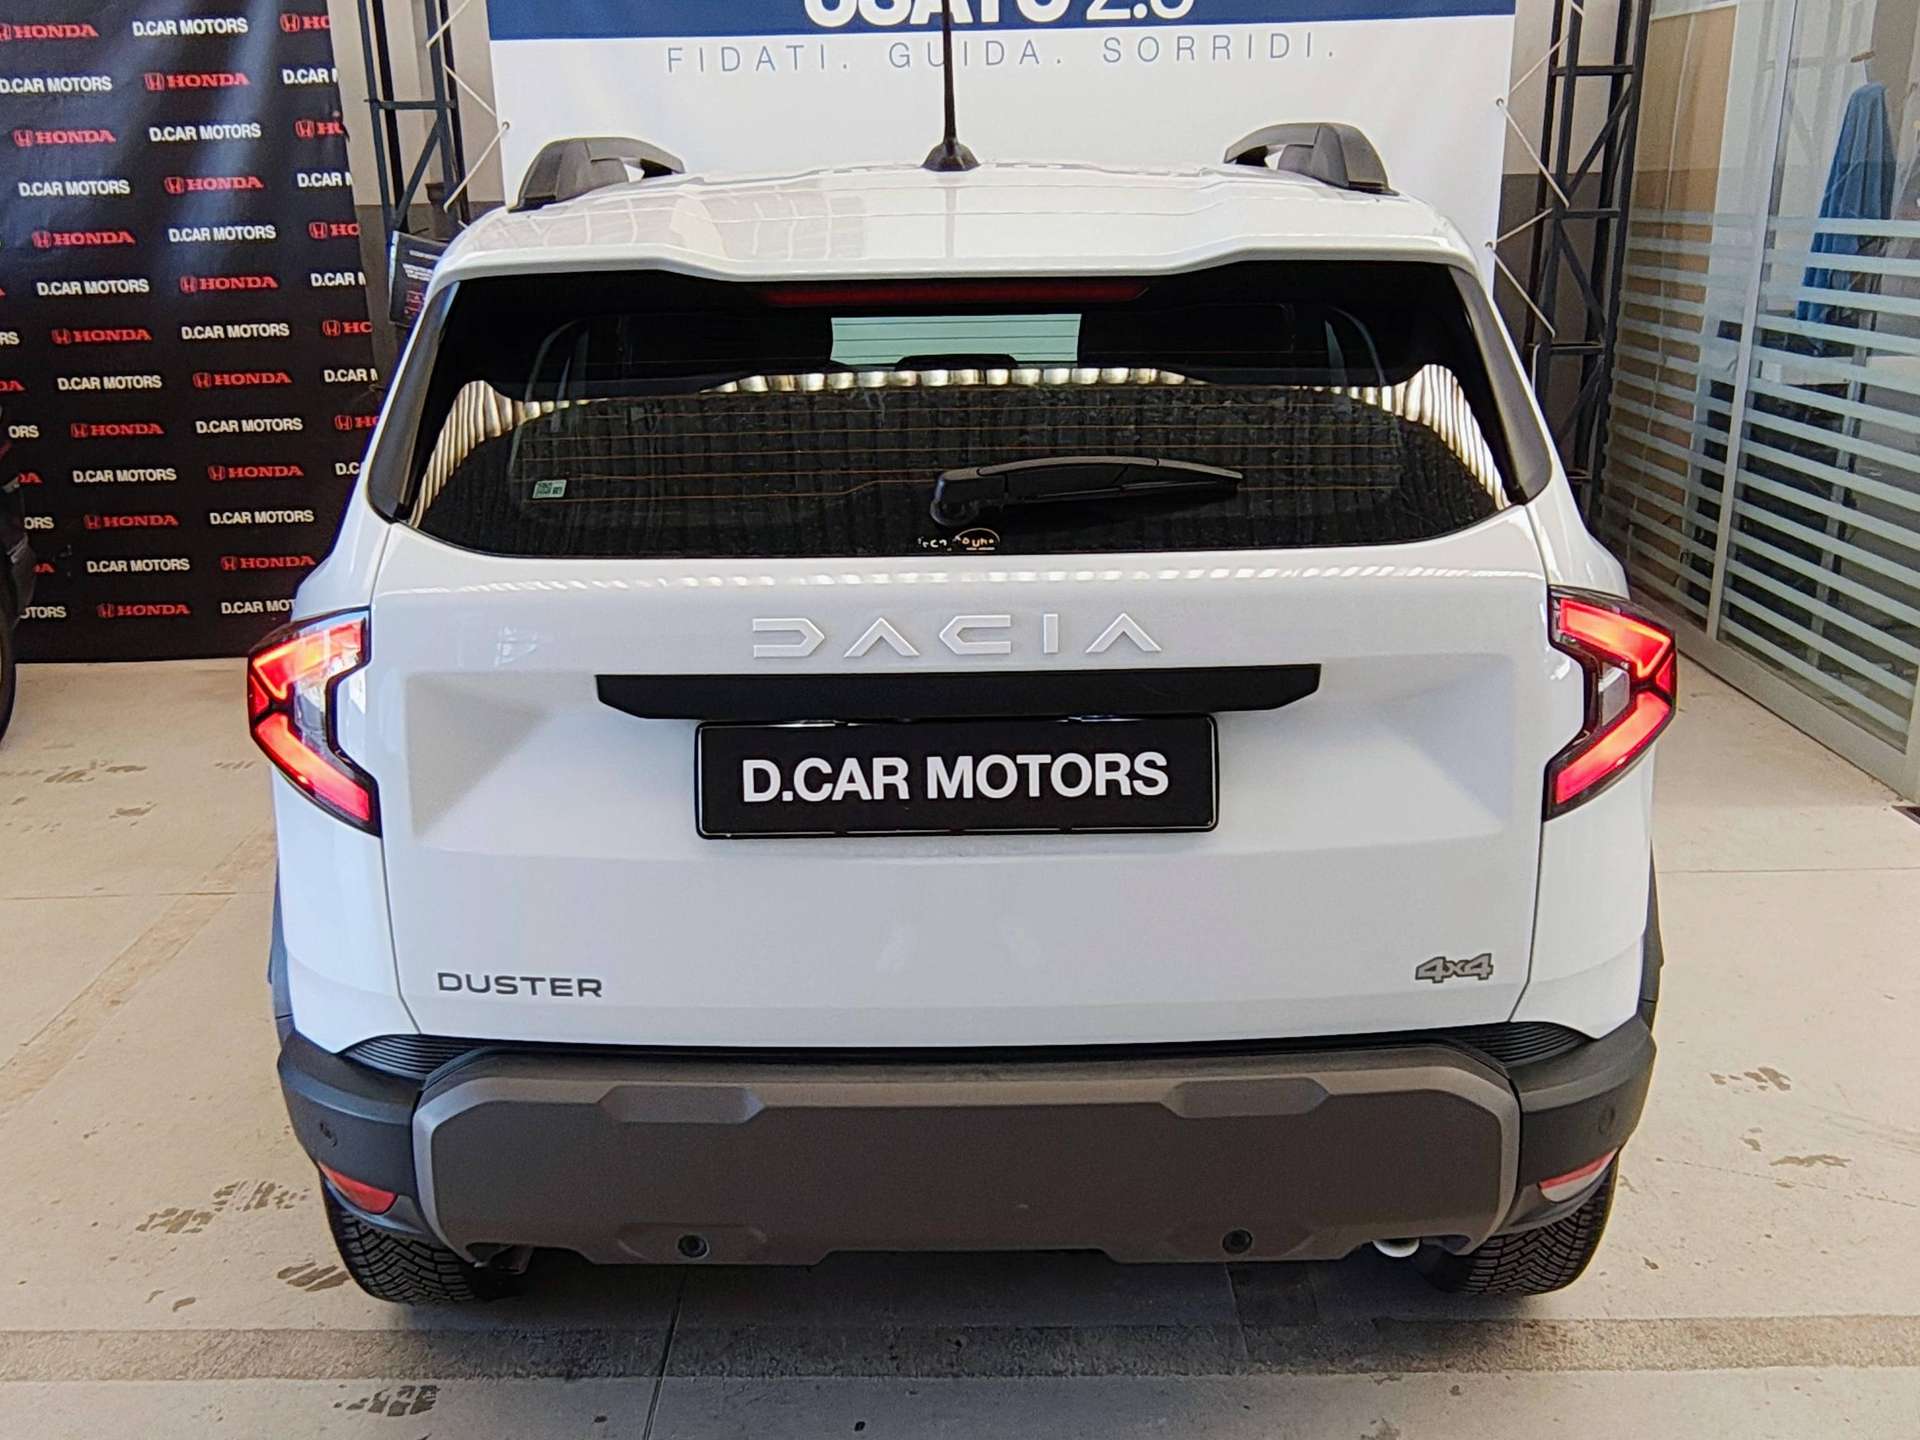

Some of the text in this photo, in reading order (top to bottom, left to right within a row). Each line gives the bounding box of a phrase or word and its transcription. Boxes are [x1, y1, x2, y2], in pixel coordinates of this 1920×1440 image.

[14, 25, 98, 38] HONDA
[133, 17, 248, 36] D.CAR MOTORS
[167, 73, 249, 88] HONDA
[282, 68, 330, 84] D.CAR
[0, 76, 112, 93] D.CAR MOTORS
[35, 130, 116, 144] HONDA
[149, 123, 261, 141] D.CAR MOTORS
[187, 176, 264, 191] HONDA
[297, 172, 342, 187] D.CAR
[18, 180, 130, 196] D.CAR MOTORS
[55, 231, 135, 246] HONDA
[169, 225, 276, 242] D.CAR MOTORS
[37, 279, 149, 295] D.CAR MOTORS
[200, 276, 278, 291] HONDA
[310, 272, 355, 287] D.CAR
[73, 329, 152, 342] HONDA
[182, 323, 289, 339] D.CAR MOTORS
[57, 375, 162, 390] D.CAR MOTORS
[215, 373, 291, 386] HONDA
[324, 368, 368, 383] D.CAR
[91, 424, 164, 436] HONDA
[196, 418, 303, 433] D.CAR MOTORS
[73, 468, 176, 482] D.CAR MOTORS
[228, 465, 304, 479] HONDA
[103, 515, 178, 527] HONDA
[210, 510, 314, 524] D.CAR MOTORS
[87, 558, 190, 573] D.CAR MOTORS
[240, 555, 315, 569] HONDA
[117, 604, 190, 617] HONDA
[221, 601, 264, 614] D.CAR
[752, 612, 1162, 658] DACIA
[742, 751, 1169, 803] D.CAR MOTORS
[1415, 953, 1494, 983] 4x4
[437, 972, 602, 998] DUSTER
